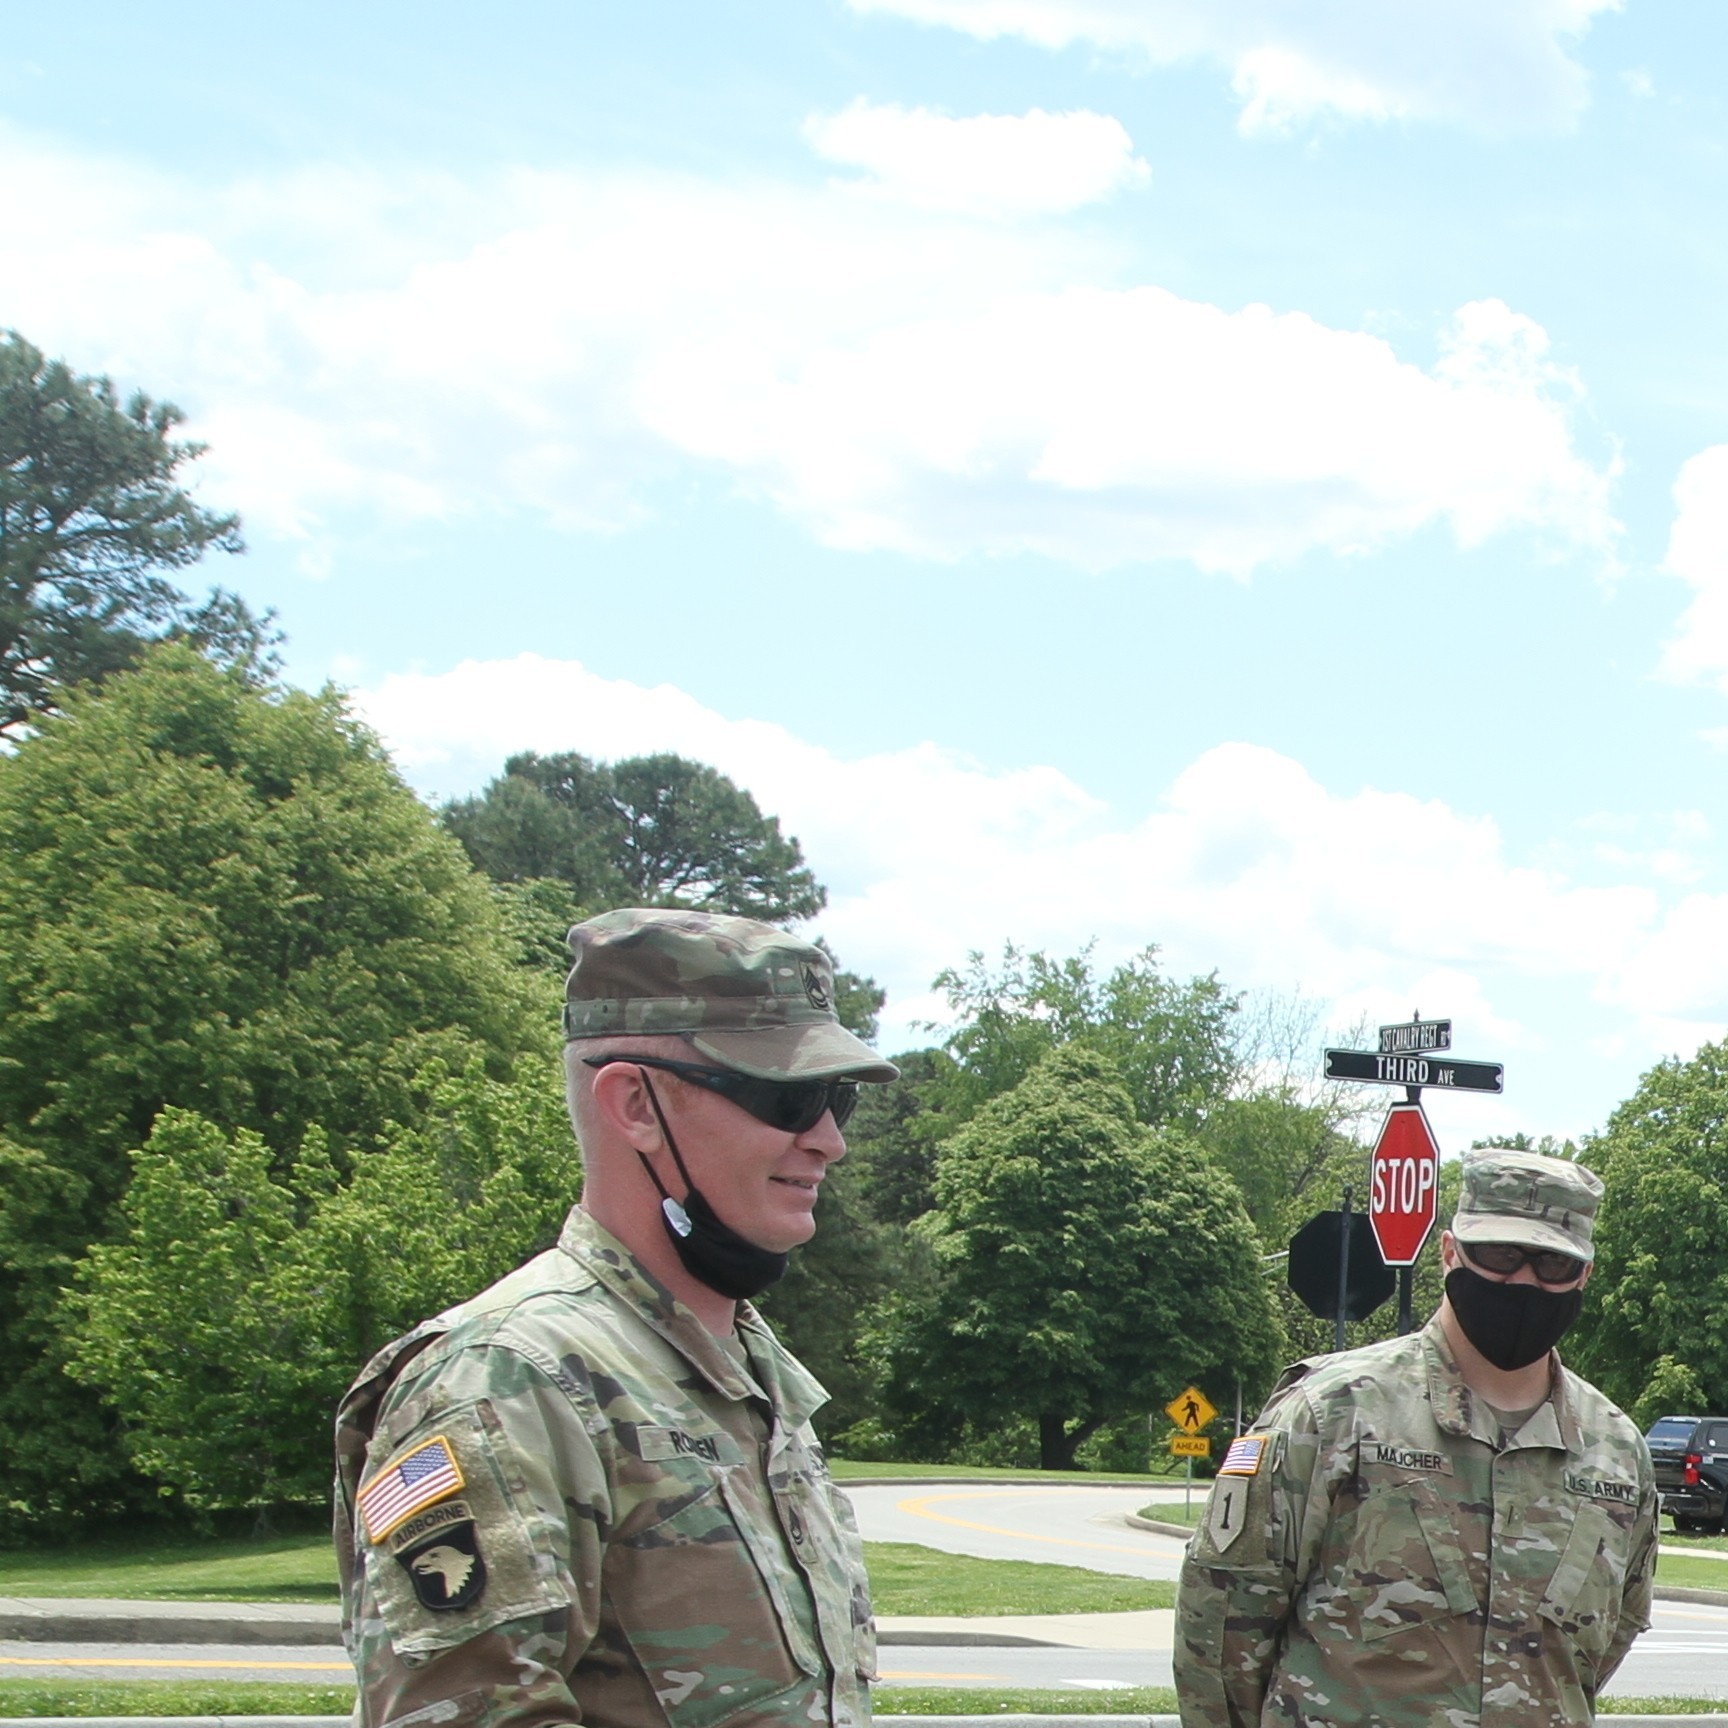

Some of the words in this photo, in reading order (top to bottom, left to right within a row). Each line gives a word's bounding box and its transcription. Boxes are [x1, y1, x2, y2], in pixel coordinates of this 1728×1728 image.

[1392, 1027, 1419, 1051] CAVALRY
[1420, 1025, 1437, 1048] REGT
[1376, 1056, 1429, 1083] THIRD
[1437, 1069, 1455, 1086] AVE
[1373, 1156, 1434, 1215] STOP
[1175, 1443, 1206, 1452] AHEAD
[1376, 1444, 1442, 1470] MAJCHER
[1595, 1480, 1634, 1501] ARMY
[396, 1504, 466, 1546] AIRBORNE
[1220, 1492, 1233, 1530] 1
